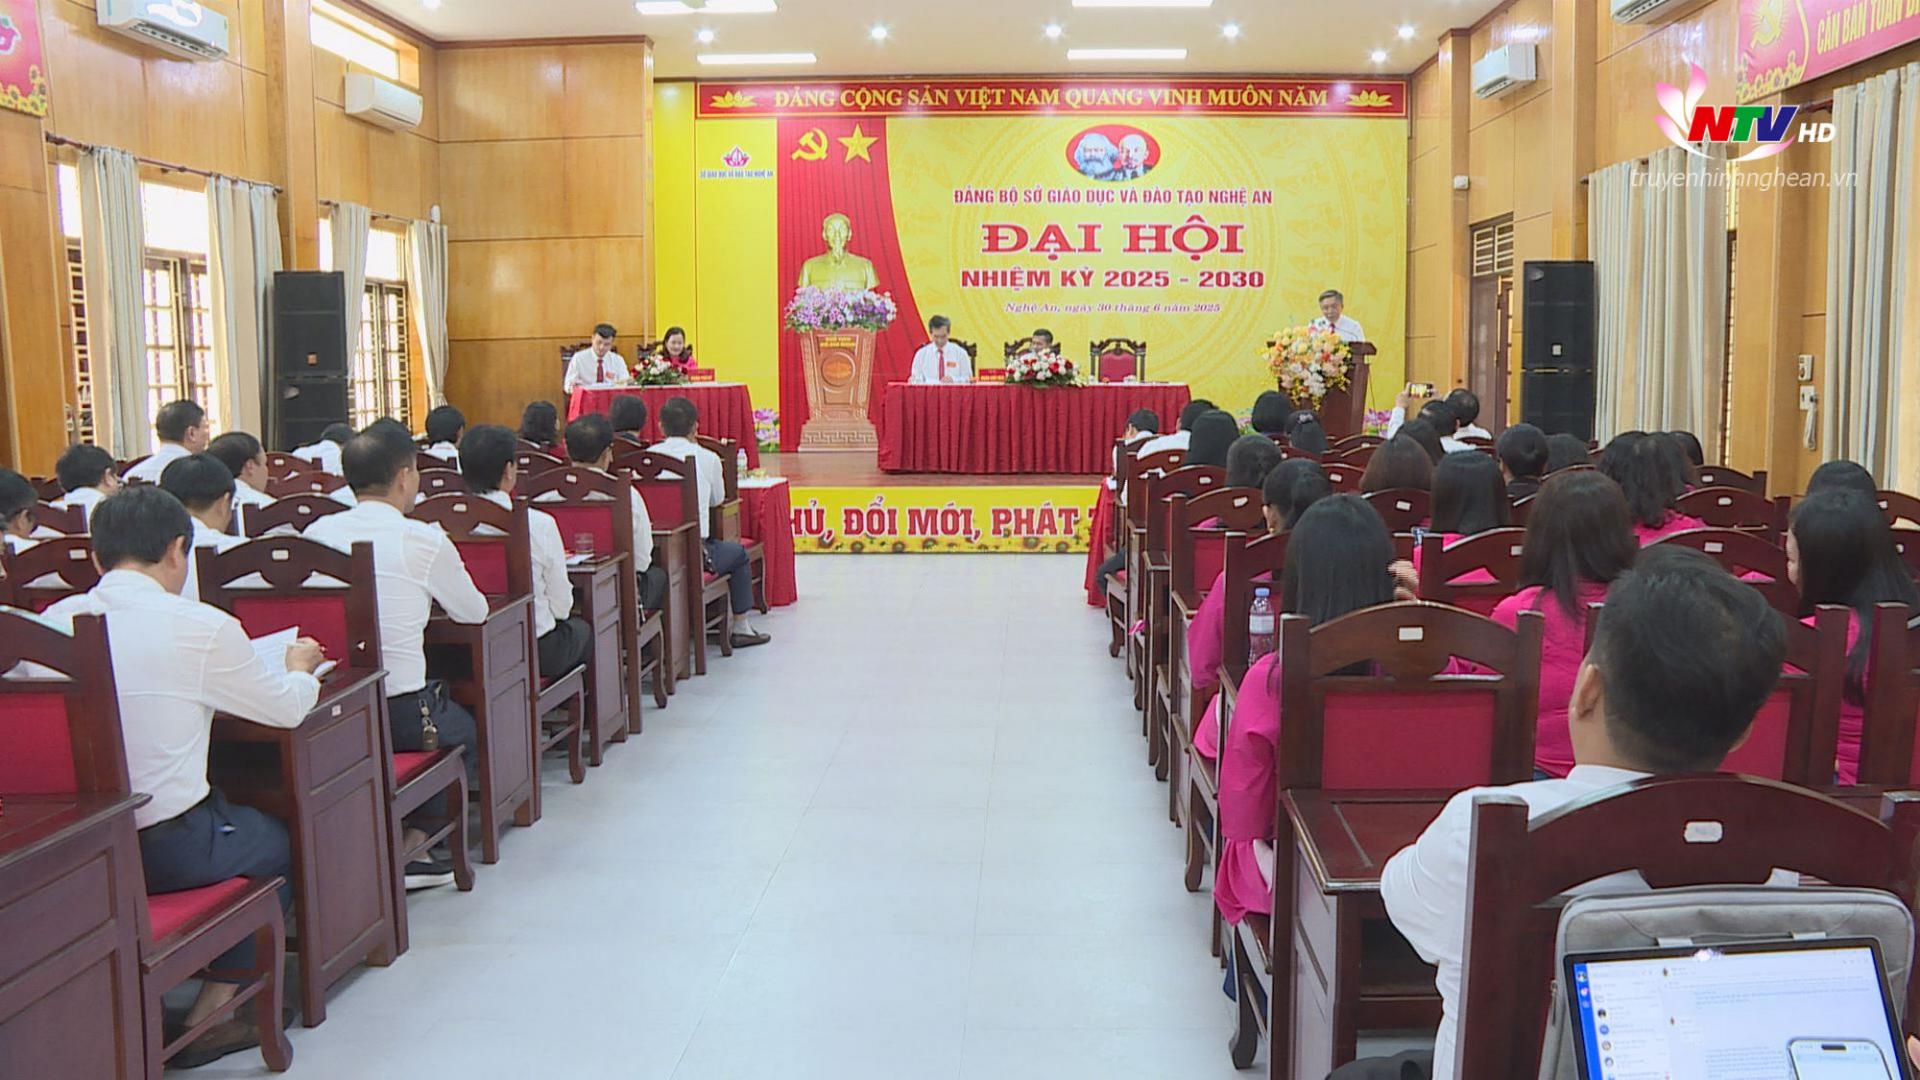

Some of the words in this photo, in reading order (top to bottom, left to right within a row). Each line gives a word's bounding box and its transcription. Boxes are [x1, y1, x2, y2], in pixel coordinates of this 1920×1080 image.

[775, 85, 835, 107] ĐẢNG
[840, 87, 902, 111] CỘNG
[908, 85, 949, 106] SẢN
[954, 86, 1005, 111] VIỆT
[1009, 88, 1059, 106] NAM
[1065, 88, 1143, 107] QUANG
[1148, 88, 1201, 106] VINH
[1206, 84, 1273, 106] MUÔN
[1278, 85, 1328, 106] NĂM
[954, 185, 994, 203] ĐẢNG
[999, 187, 1018, 206] BỘ
[1023, 185, 1042, 203] SỞ
[1048, 186, 1081, 203] GIÁO
[1086, 190, 1114, 206] DỤC
[1120, 187, 1138, 203] VÀ
[1143, 187, 1172, 203] ĐÀO
[1177, 190, 1203, 206] TẠO
[1208, 188, 1246, 206] NGHỆ
[1252, 190, 1272, 203] AN
[981, 224, 1102, 261] ĐẠI
[1122, 214, 1244, 261] HỘI
[961, 266, 1050, 291] NHIỆM
[1104, 271, 1169, 287] 2025
[1199, 271, 1263, 287] 2030
[1097, 303, 1112, 312] 30
[1154, 303, 1160, 312] 6
[1194, 303, 1220, 312] 2025
[843, 495, 897, 536] ĐỔI
[992, 502, 1078, 536] PHÁT
